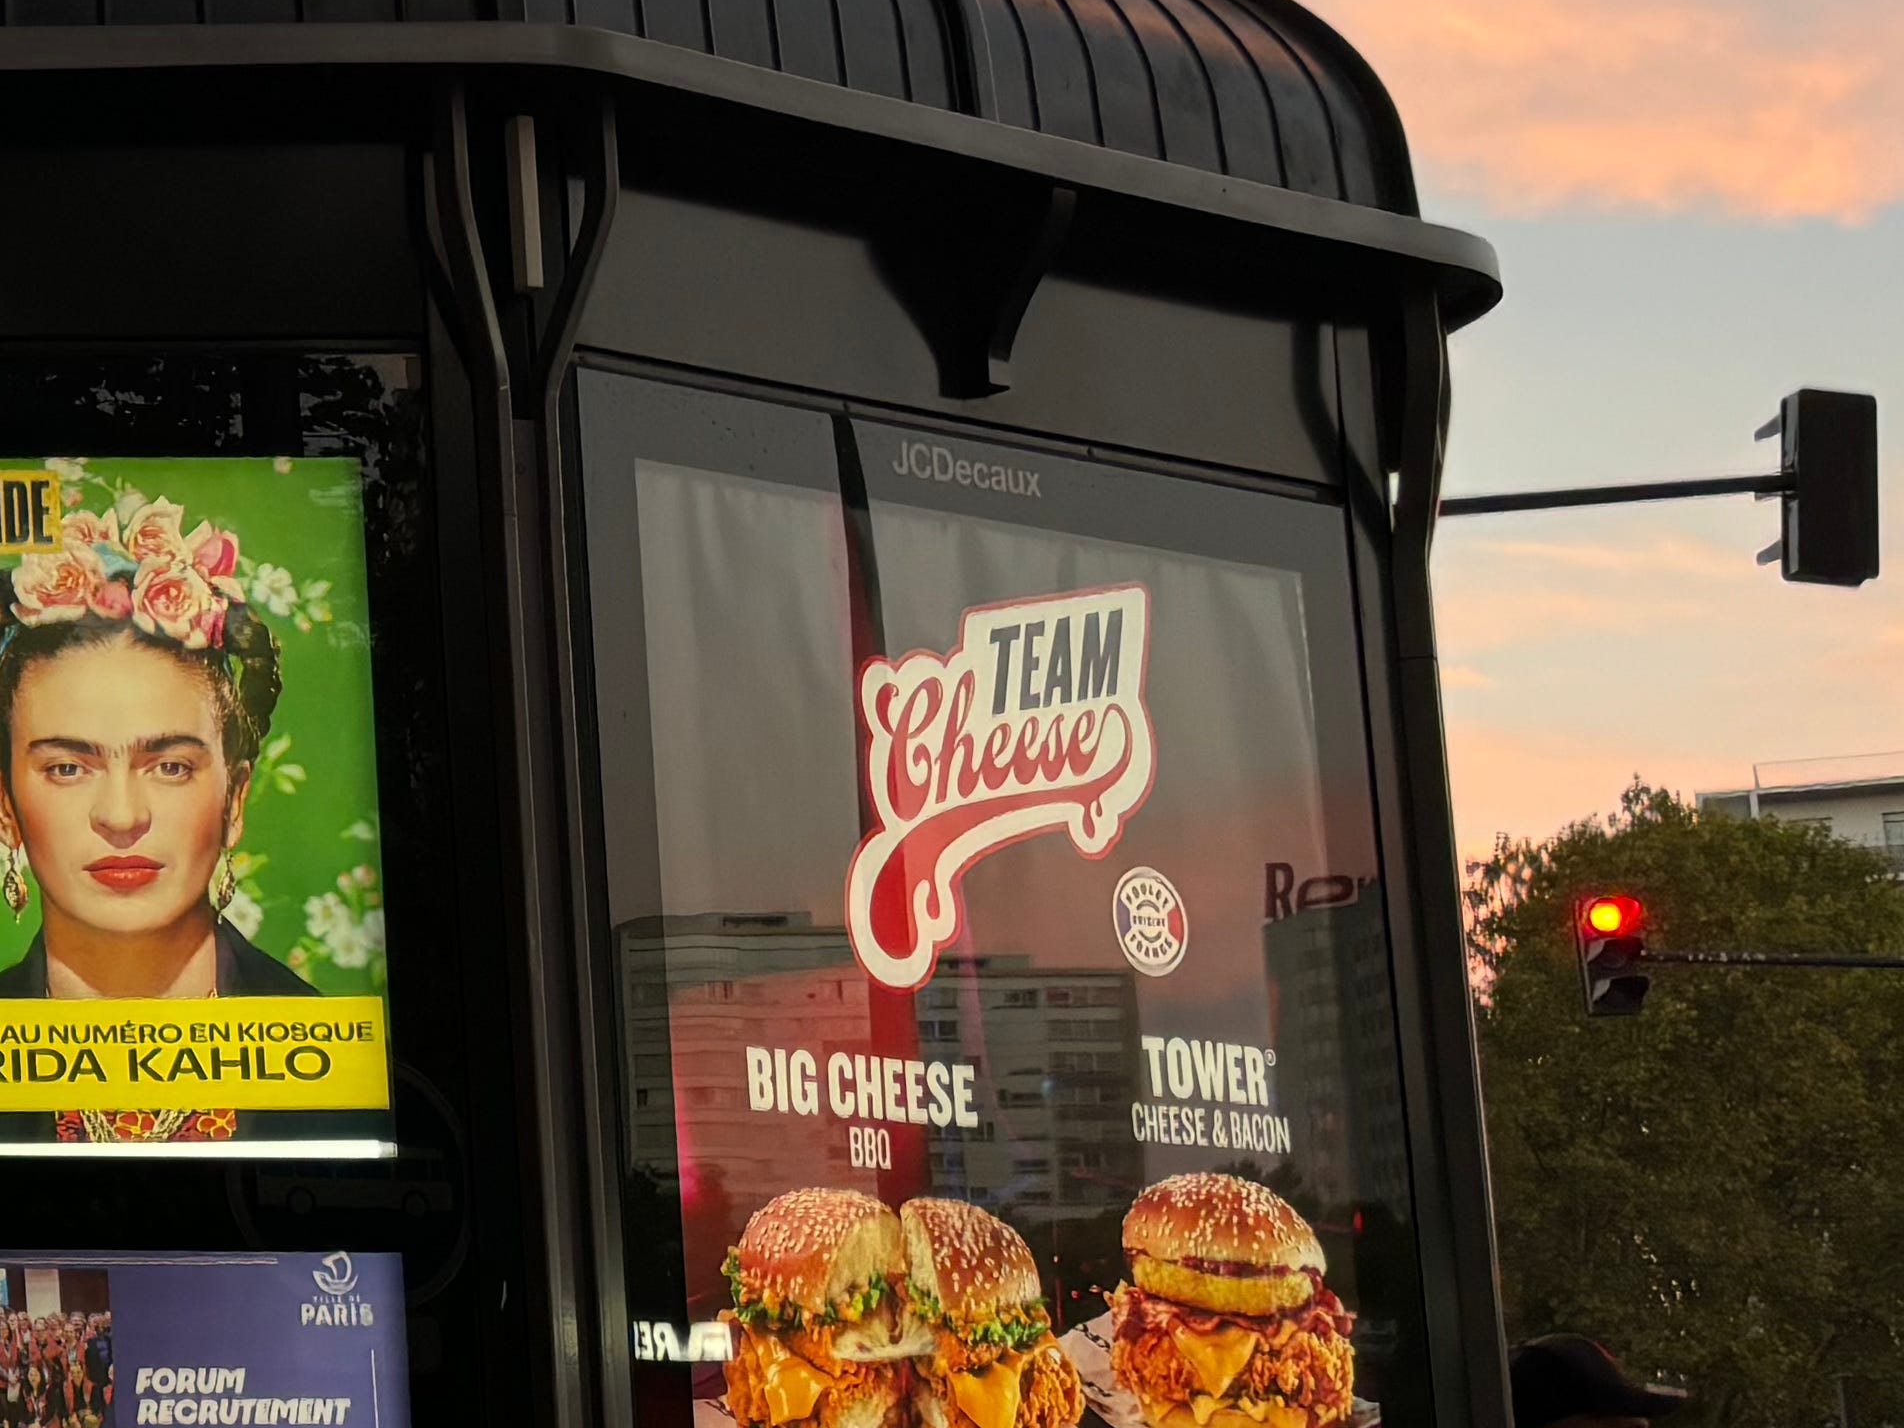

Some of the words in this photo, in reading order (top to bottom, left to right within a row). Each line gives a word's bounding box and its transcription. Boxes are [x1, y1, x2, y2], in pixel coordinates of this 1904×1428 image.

[892, 440, 1042, 499] JCDecaux
[988, 609, 1123, 715] TEAM
[49, 1018, 182, 1044] NUMÉRO
[191, 1022, 232, 1043] EN
[238, 1020, 372, 1043] KIOSQUE
[128, 1046, 331, 1082] KAHLO
[745, 1047, 818, 1120] BIG
[826, 1053, 979, 1129] CHEESE
[849, 1125, 893, 1170] BBQ
[1131, 1102, 1207, 1149] CHEESE
[1212, 1116, 1228, 1150] &
[1231, 1111, 1290, 1155] BACON
[301, 1303, 373, 1326] PARIS
[136, 1367, 245, 1394] FORUM
[137, 1397, 351, 1426] RECRUTEMENT
